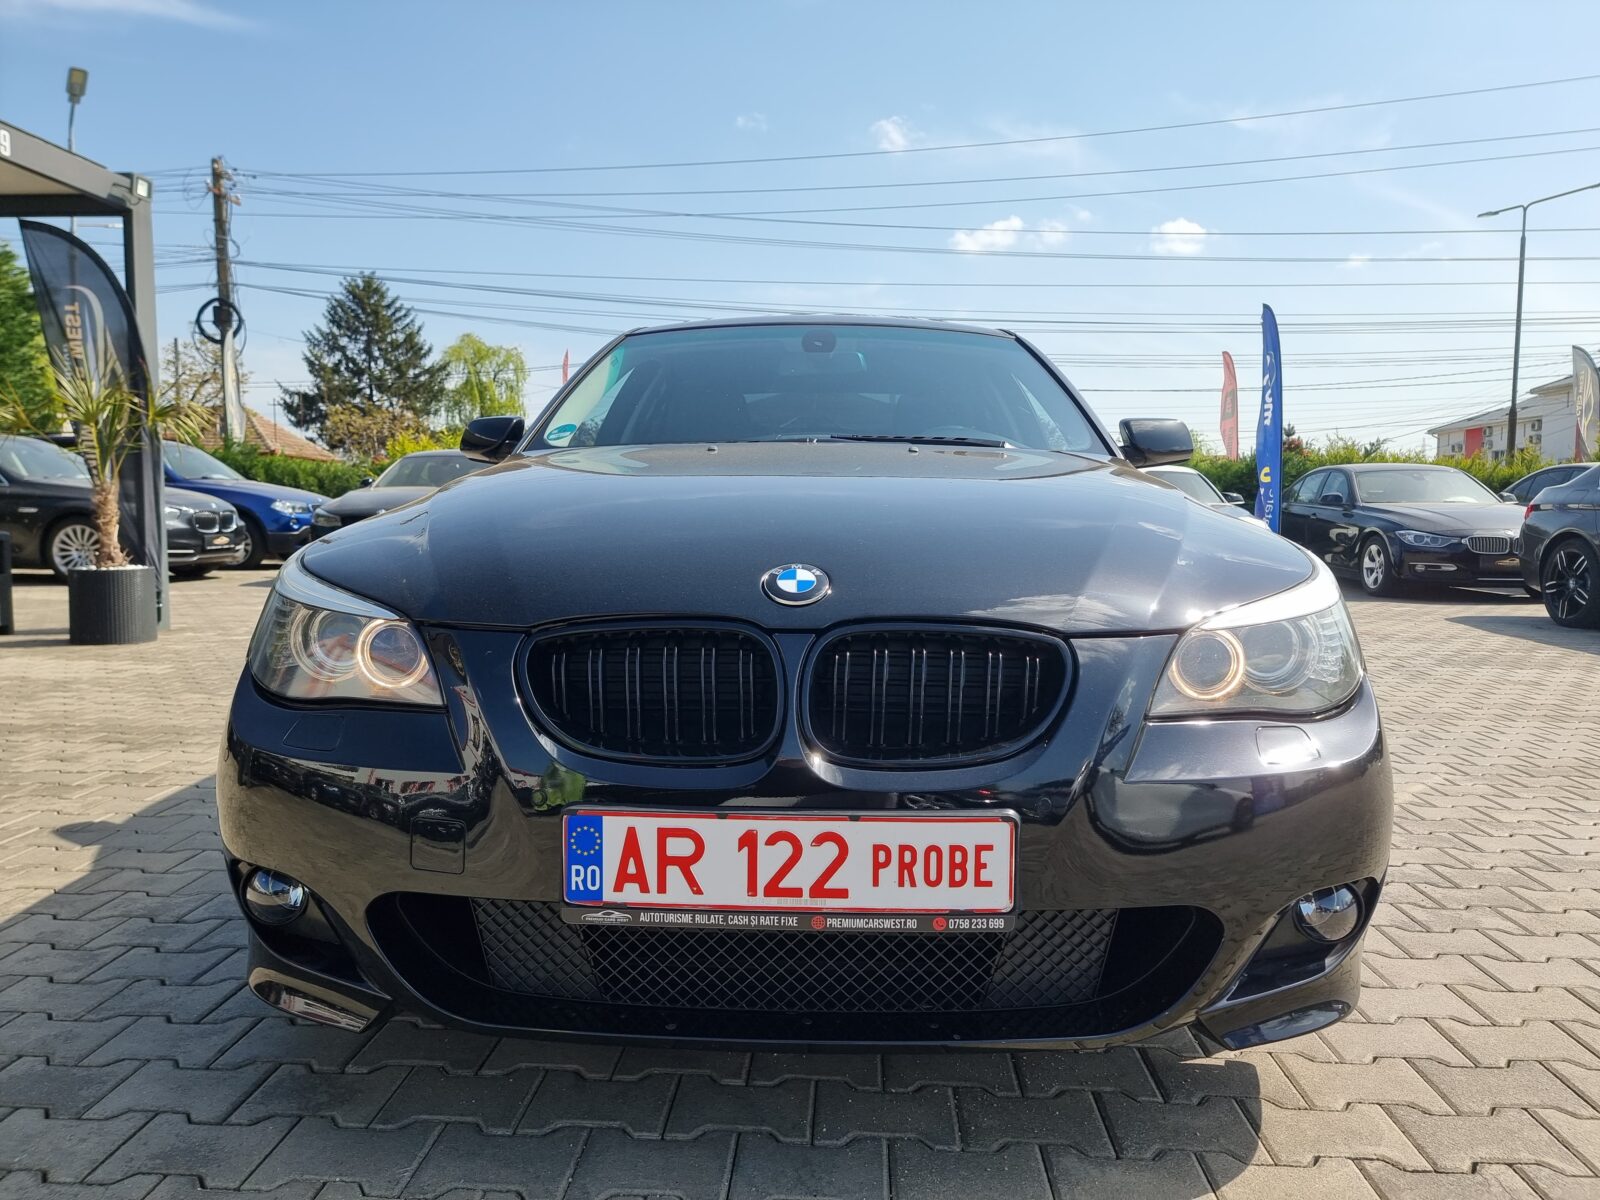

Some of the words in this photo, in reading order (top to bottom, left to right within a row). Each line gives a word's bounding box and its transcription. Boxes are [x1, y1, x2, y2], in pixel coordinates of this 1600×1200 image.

[612, 826, 705, 896] AR
[738, 829, 849, 899] 122
[872, 844, 994, 888] PROBE
[571, 864, 600, 891] RO
[639, 912, 694, 924] AUTOTURISME
[695, 914, 727, 926] RULATE,
[728, 915, 749, 925] CASH
[759, 916, 779, 926] RATE
[781, 916, 799, 927] FIXE
[826, 918, 917, 930] PREMIUMCARSWEST.RO
[948, 919, 970, 929] 0758
[971, 919, 987, 929] 233
[988, 918, 1005, 929] 699
